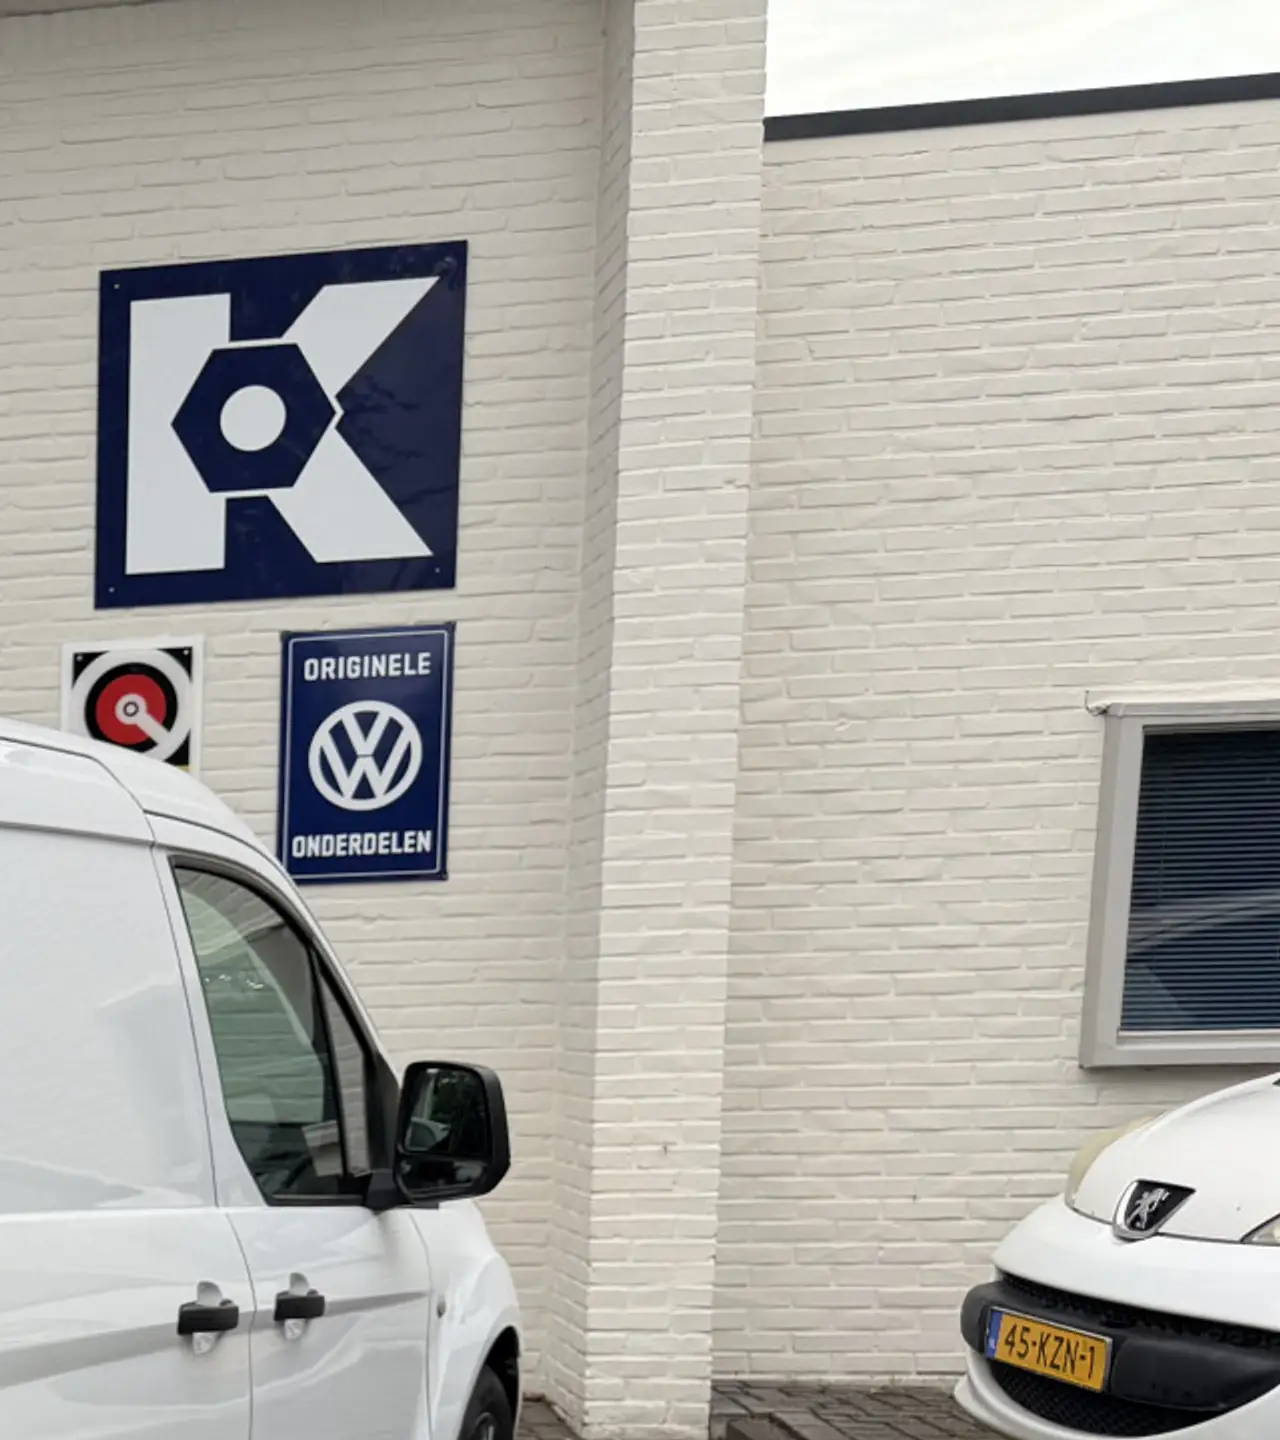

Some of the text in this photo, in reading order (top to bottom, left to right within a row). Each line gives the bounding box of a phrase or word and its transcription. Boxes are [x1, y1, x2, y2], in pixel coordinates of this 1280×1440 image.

[303, 652, 431, 681] ORIGINELE
[291, 830, 433, 859] ONDERDELEN
[1003, 1323, 1097, 1380] 45-KZN-1
